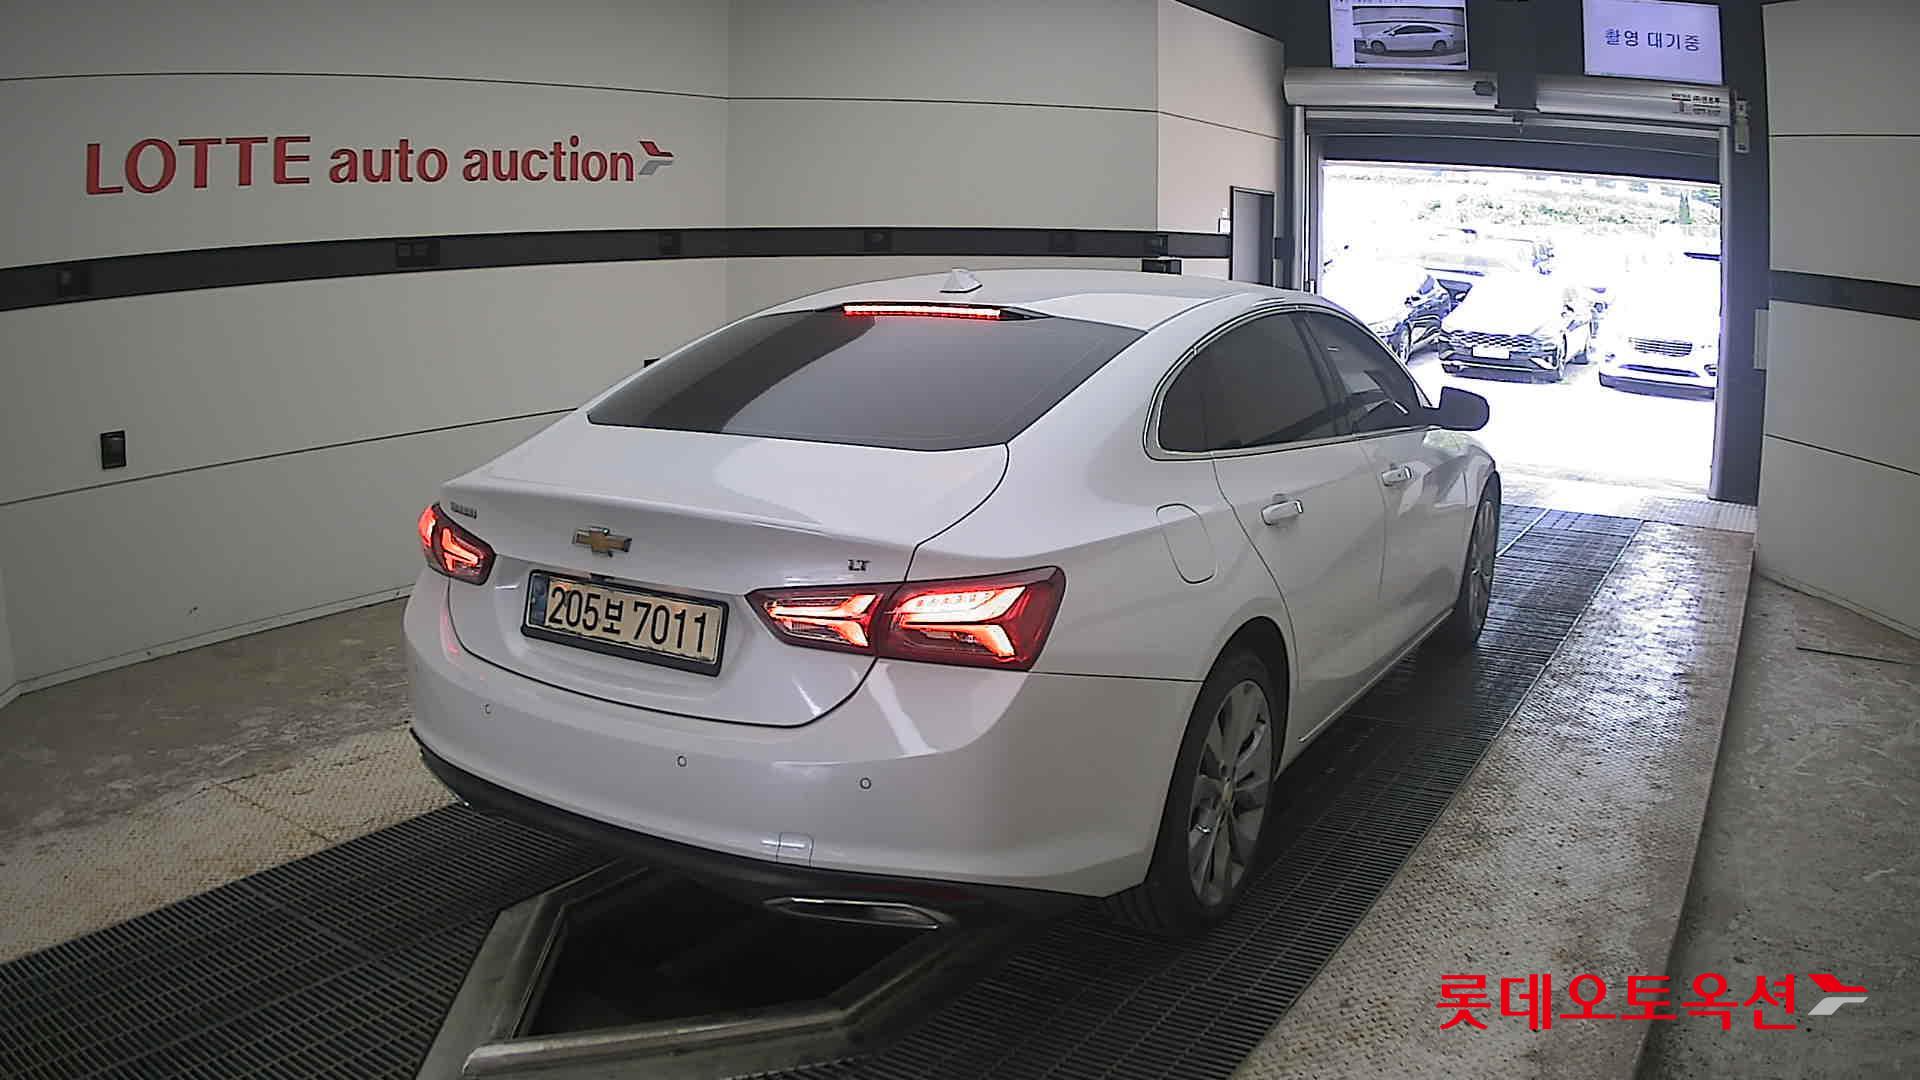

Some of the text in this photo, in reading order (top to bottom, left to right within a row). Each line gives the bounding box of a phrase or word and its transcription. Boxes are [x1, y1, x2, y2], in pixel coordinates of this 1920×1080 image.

[1646, 32, 1700, 52] 대기중
[86, 135, 636, 195] LOTTE auto auction
[550, 586, 707, 653] 205보 7011
